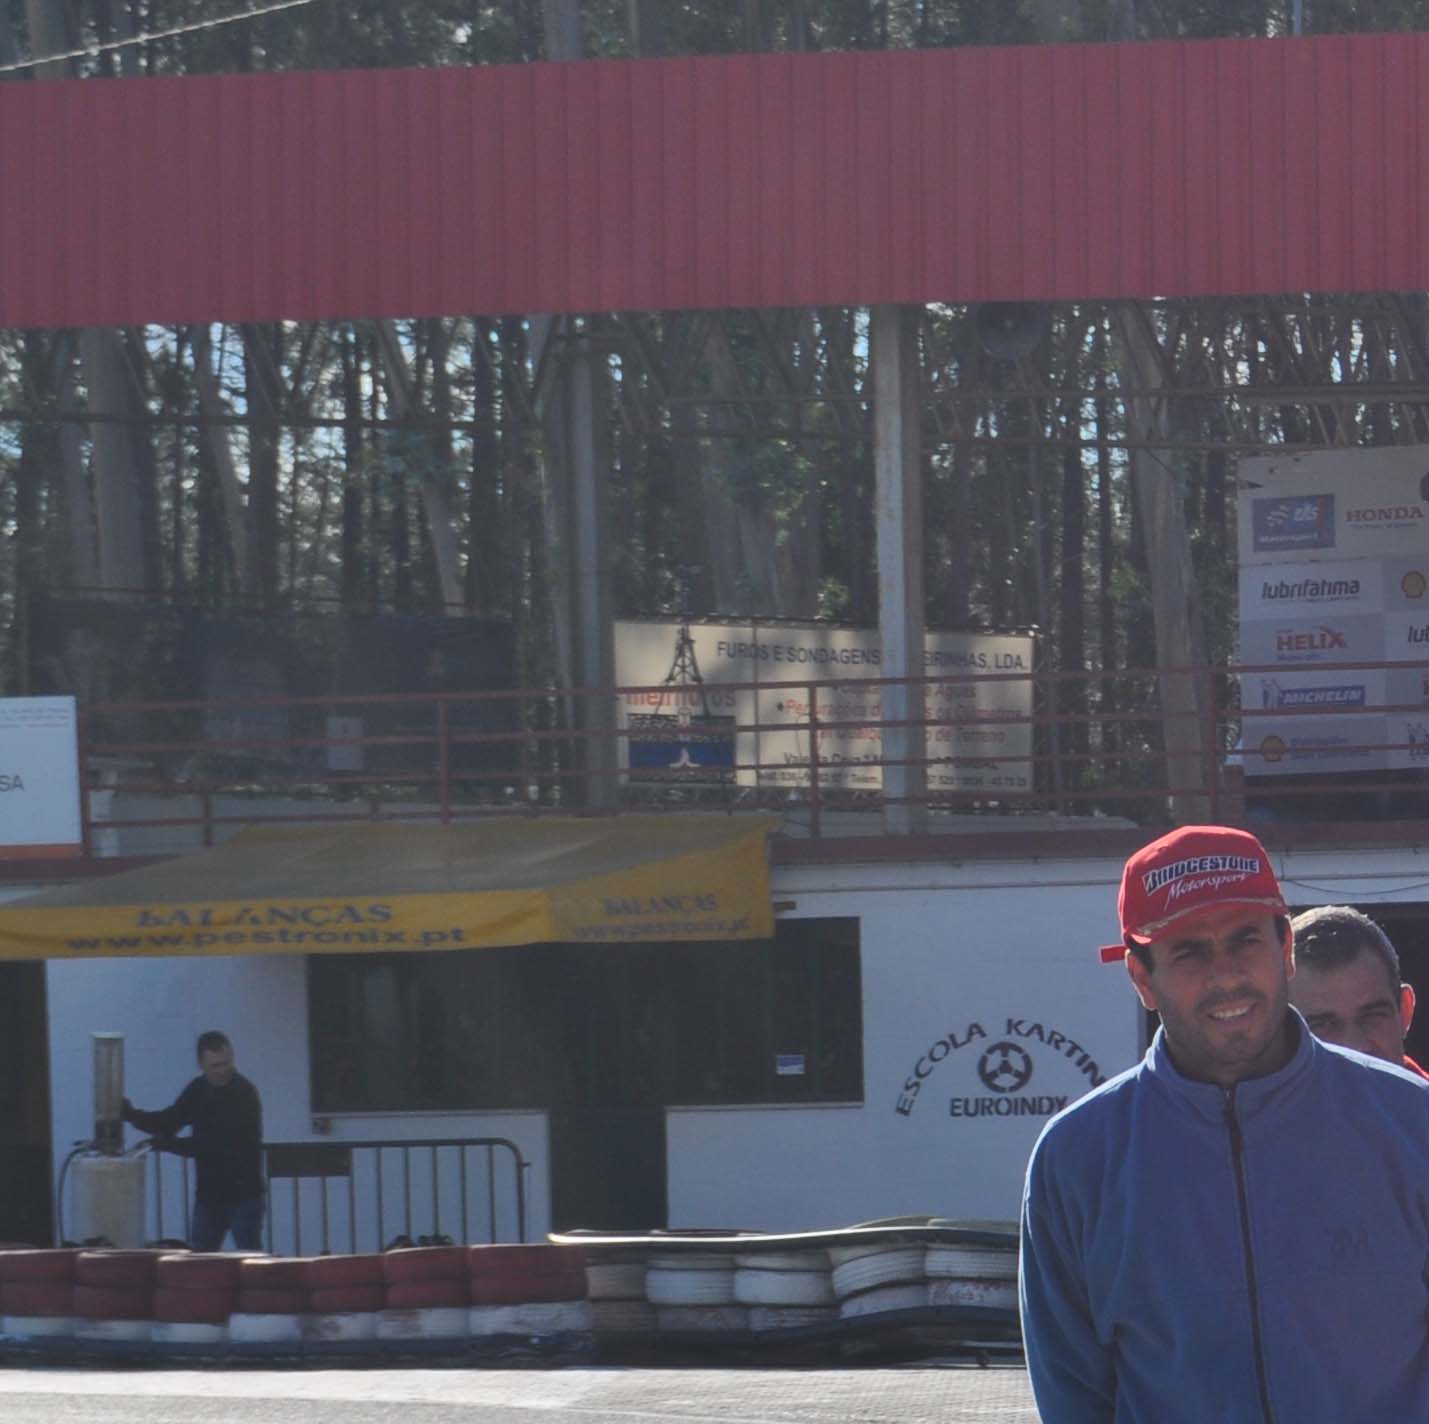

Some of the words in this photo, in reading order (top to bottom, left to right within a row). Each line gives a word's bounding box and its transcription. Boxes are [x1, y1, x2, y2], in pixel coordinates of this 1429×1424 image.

[1347, 506, 1424, 521] HONDA
[785, 643, 881, 667] SONDAGENS
[1282, 686, 1364, 705] MICHELIN
[1164, 873, 1246, 911] Motorsport
[896, 1021, 987, 1117] ESCOLA
[1005, 1018, 1106, 1088] KARTIN
[949, 1095, 1068, 1118] EUROINDY
